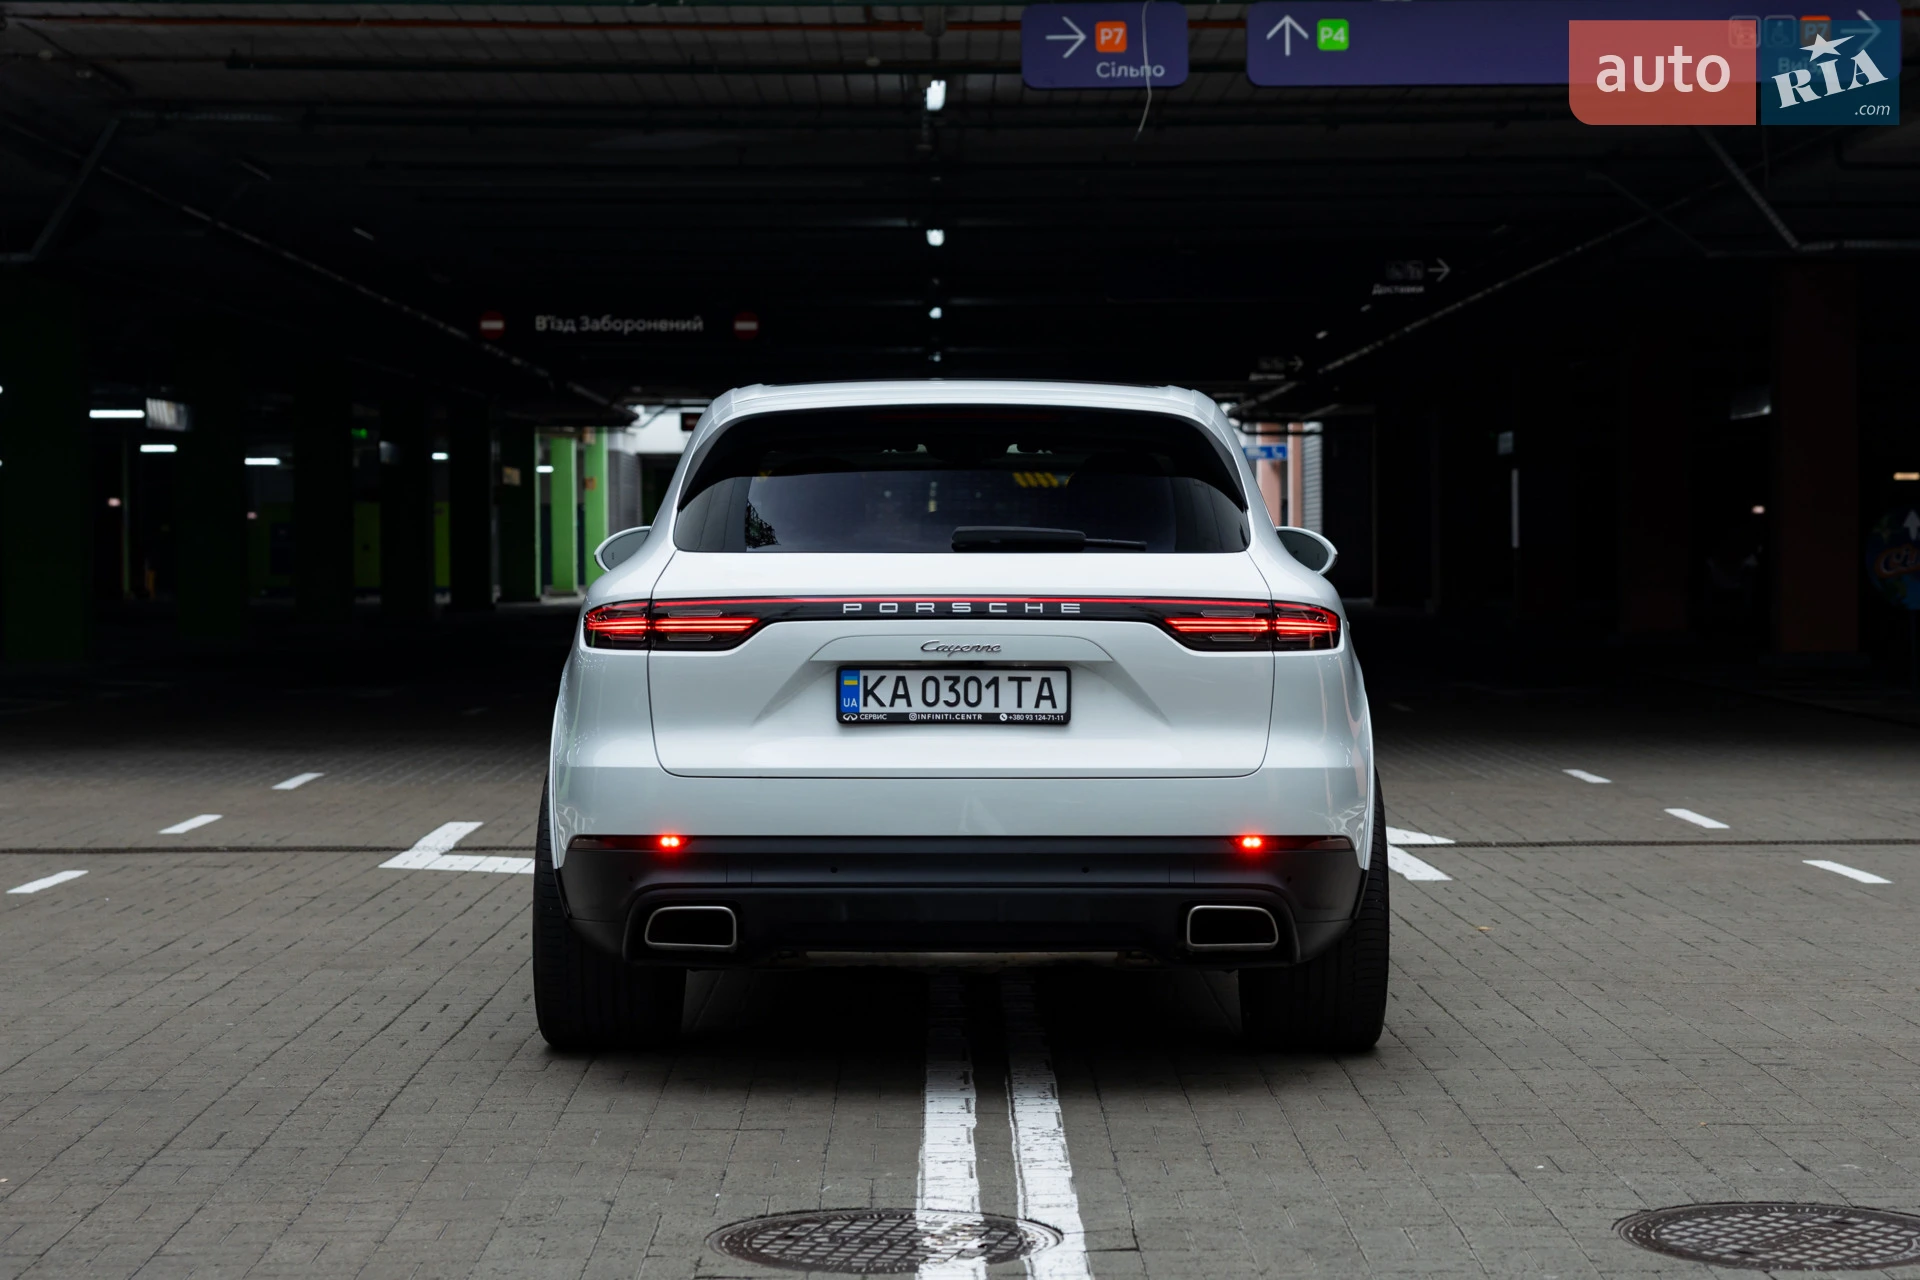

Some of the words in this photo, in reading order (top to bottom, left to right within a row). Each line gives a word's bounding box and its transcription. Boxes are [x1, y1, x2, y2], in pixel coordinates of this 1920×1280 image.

[1100, 27, 1124, 45] P7
[1320, 27, 1346, 43] P4
[1096, 61, 1165, 78] Сільпо
[535, 315, 577, 333] В'їзд
[579, 314, 704, 336] Заборонений
[843, 602, 1081, 614] PORSCHE
[920, 639, 1002, 657] Cayenne
[862, 675, 913, 708] KA
[921, 675, 1000, 708] 0301
[1007, 676, 1058, 709] TA
[843, 697, 858, 708] UA
